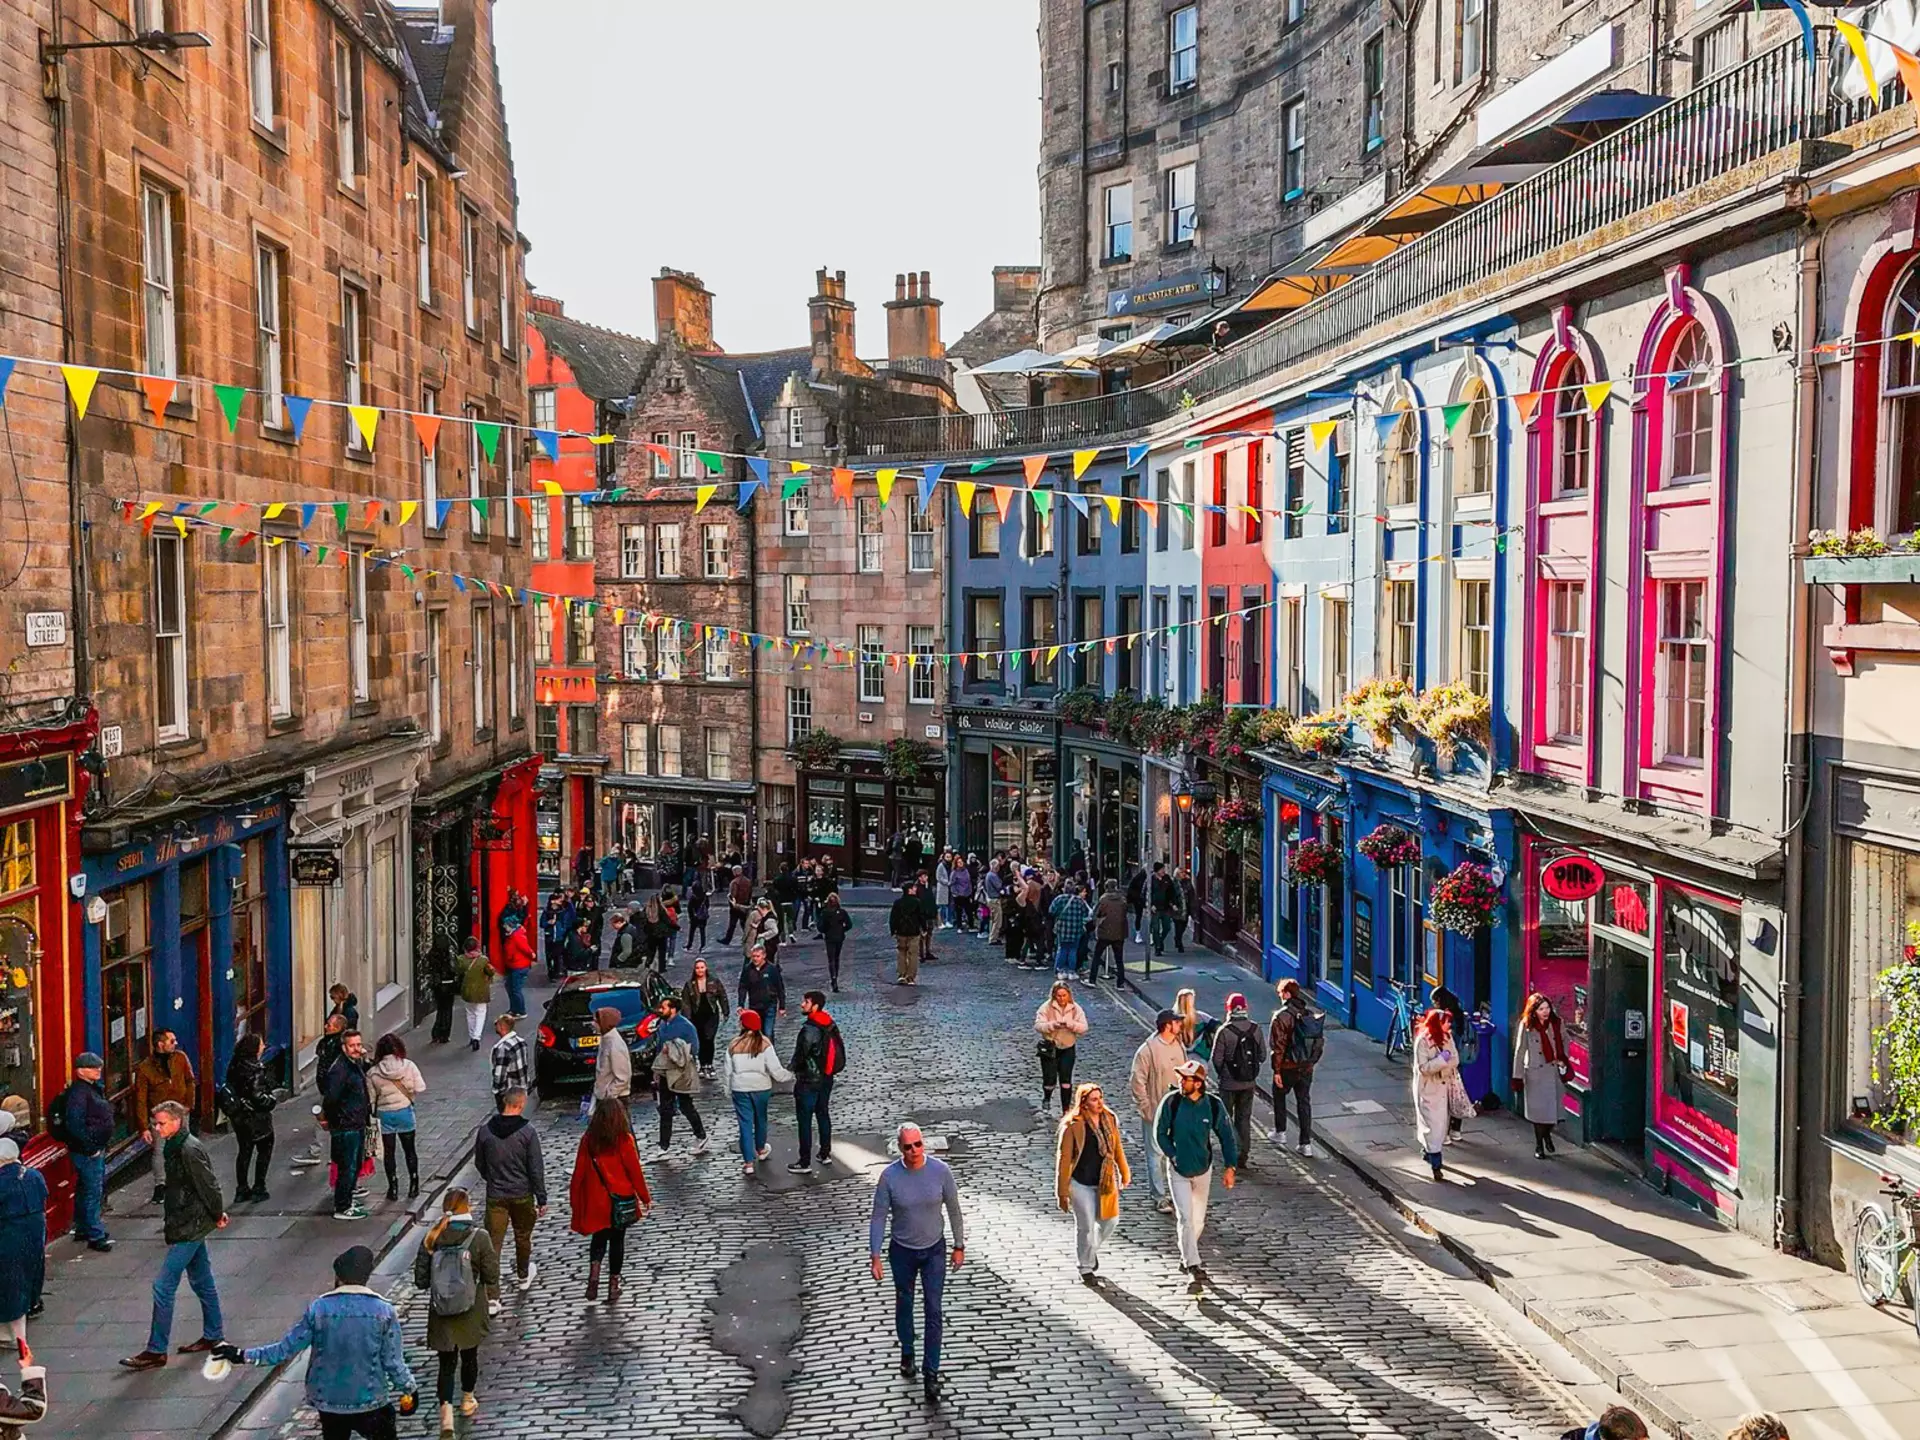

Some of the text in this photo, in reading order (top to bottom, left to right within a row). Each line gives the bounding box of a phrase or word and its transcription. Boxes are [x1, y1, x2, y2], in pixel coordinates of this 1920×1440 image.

[29, 615, 63, 628] VICTORIA
[34, 629, 60, 643] STREET
[984, 719, 1014, 731] Walker
[1019, 719, 1045, 734] Slater
[104, 728, 120, 741] WEST
[105, 743, 119, 757] BOW
[339, 766, 374, 796] SAHARA
[117, 850, 144, 872] SPIRIT
